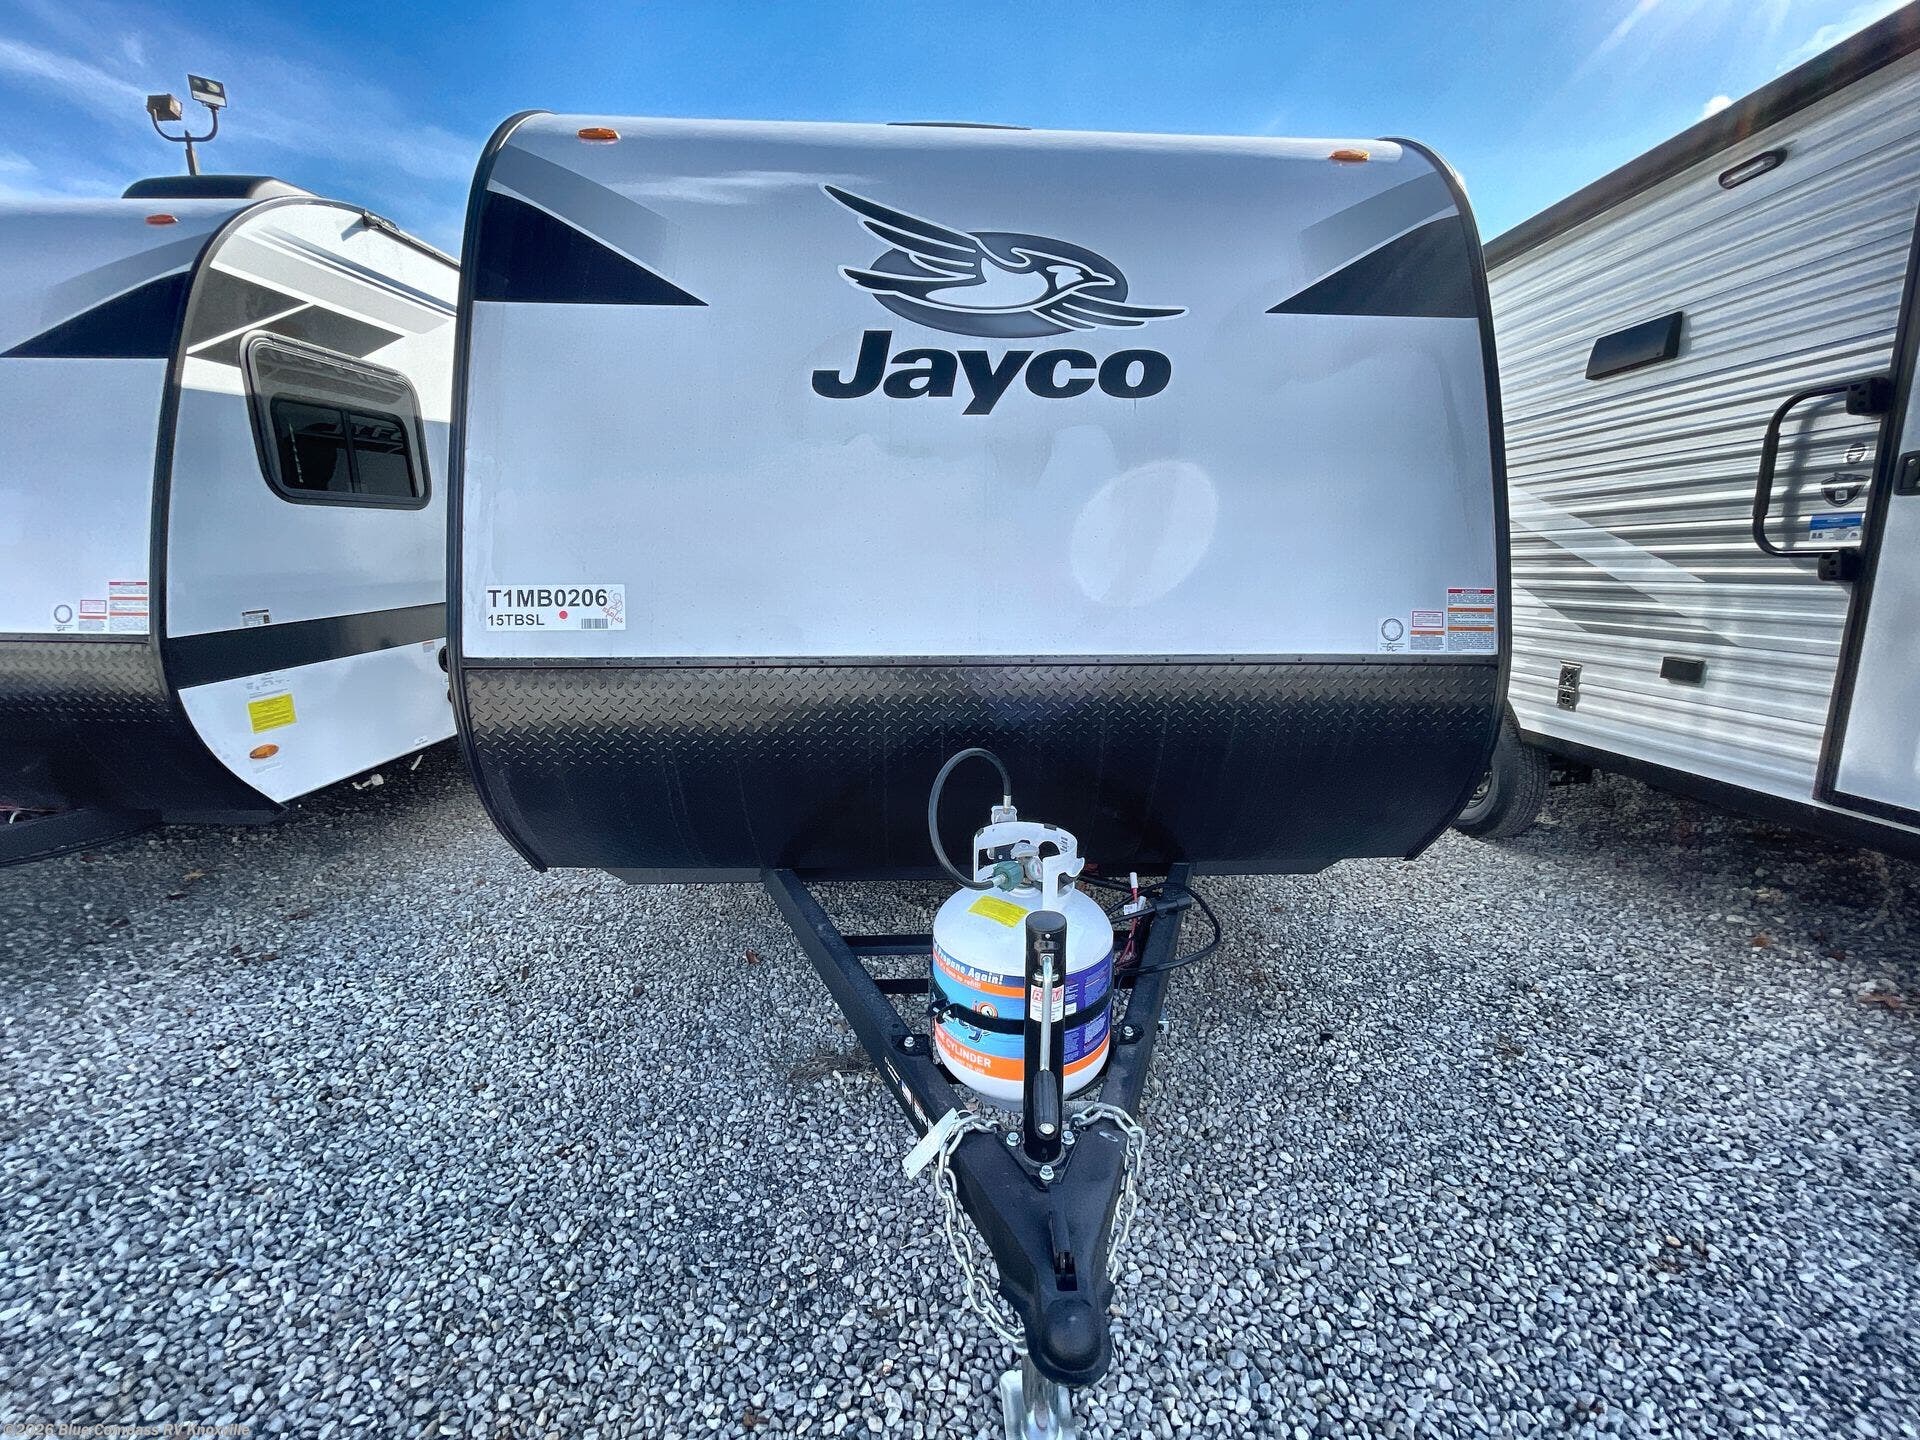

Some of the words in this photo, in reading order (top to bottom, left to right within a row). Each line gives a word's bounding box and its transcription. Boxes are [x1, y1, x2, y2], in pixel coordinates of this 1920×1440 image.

[811, 329, 1172, 415] Jayco
[487, 588, 608, 608] T1MB0206
[487, 614, 545, 626] 15TBSL
[968, 967, 1004, 985] Again!
[946, 1040, 992, 1068] CYLINDER
